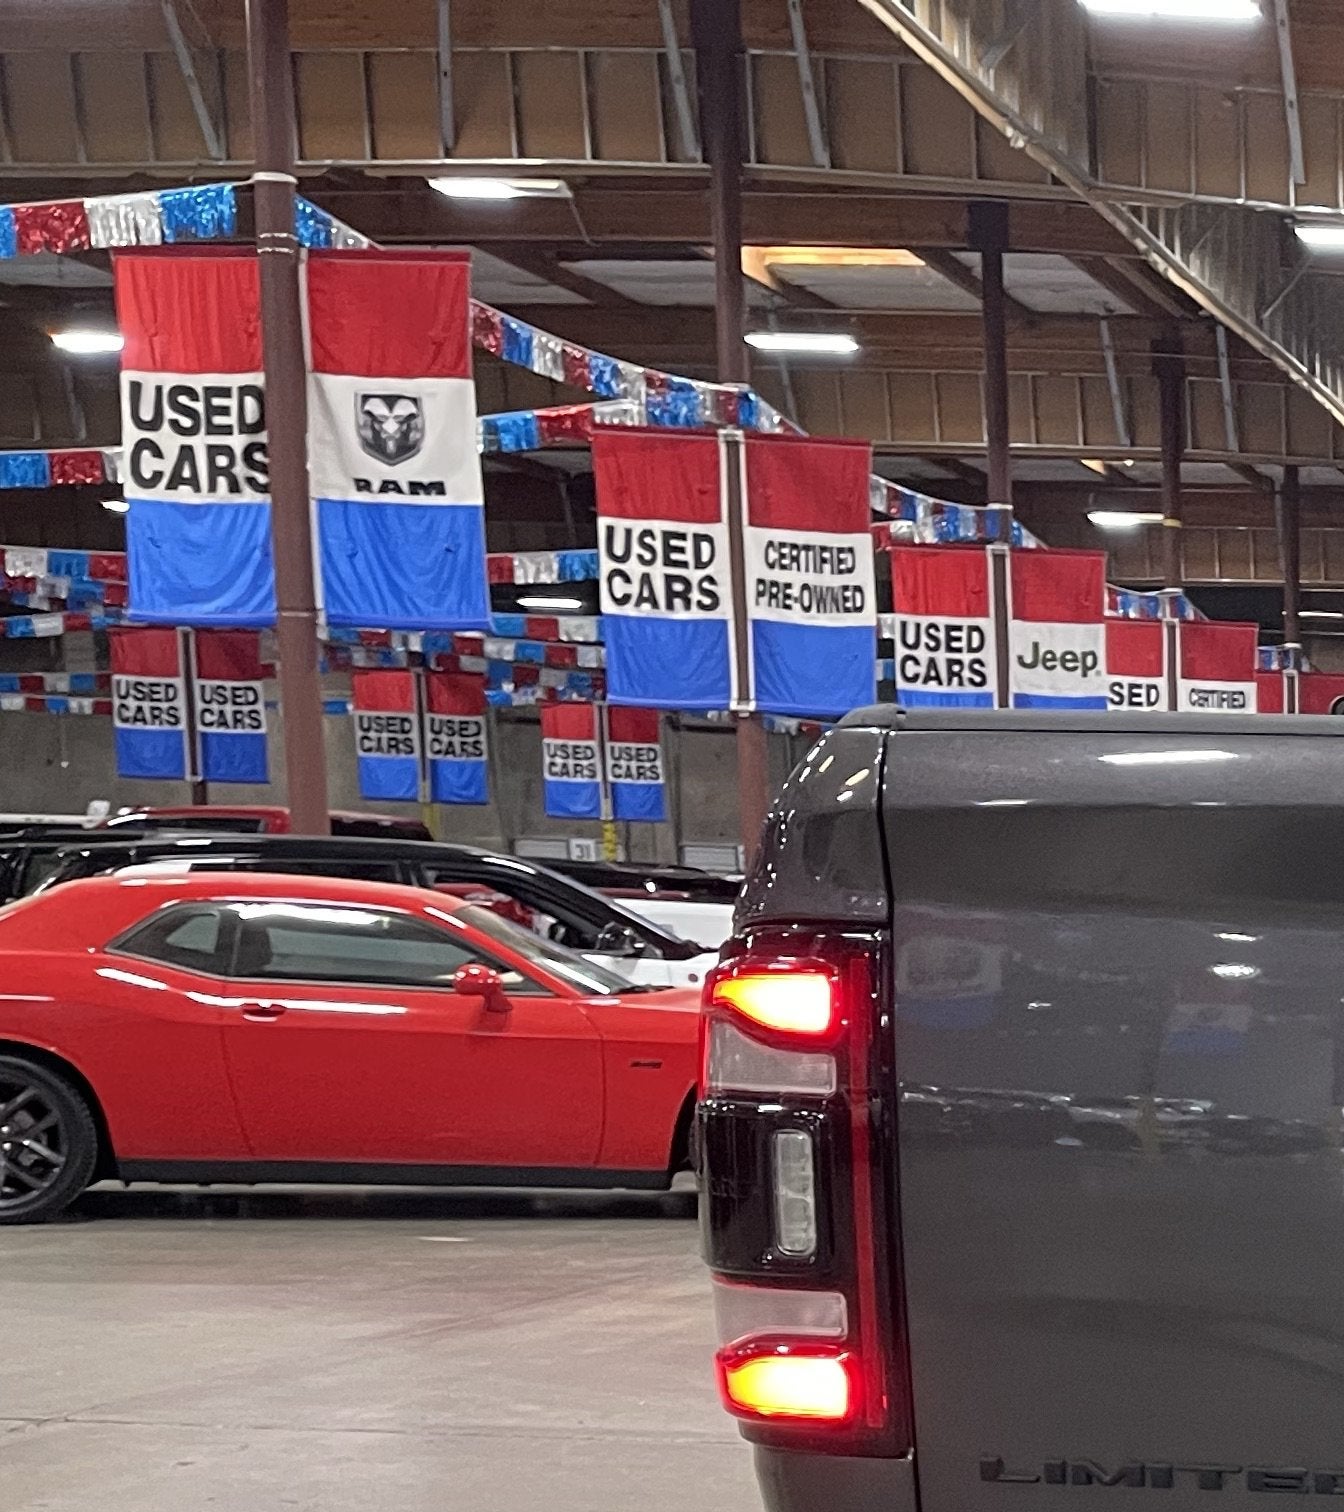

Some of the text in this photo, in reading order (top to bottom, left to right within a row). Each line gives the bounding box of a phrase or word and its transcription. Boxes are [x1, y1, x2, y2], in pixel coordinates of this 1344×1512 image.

[129, 380, 266, 437] USED
[129, 437, 270, 495] CARS
[353, 478, 447, 496] RAM
[605, 524, 716, 570] USED
[764, 540, 856, 575] CERTIFIED
[607, 568, 720, 611] CARS
[754, 578, 865, 614] PRE-OWNED
[900, 620, 985, 654] USED
[900, 654, 987, 688] CARS
[1016, 641, 1099, 678] Jeep
[116, 679, 178, 702] USED
[200, 684, 260, 706] USED
[1109, 682, 1160, 707] SED
[117, 703, 180, 726] CARS
[200, 707, 262, 729] CARS
[359, 715, 413, 734] USED
[430, 717, 481, 738] USED
[546, 743, 595, 760] USED
[610, 745, 658, 762] USED
[548, 762, 597, 778] CARS
